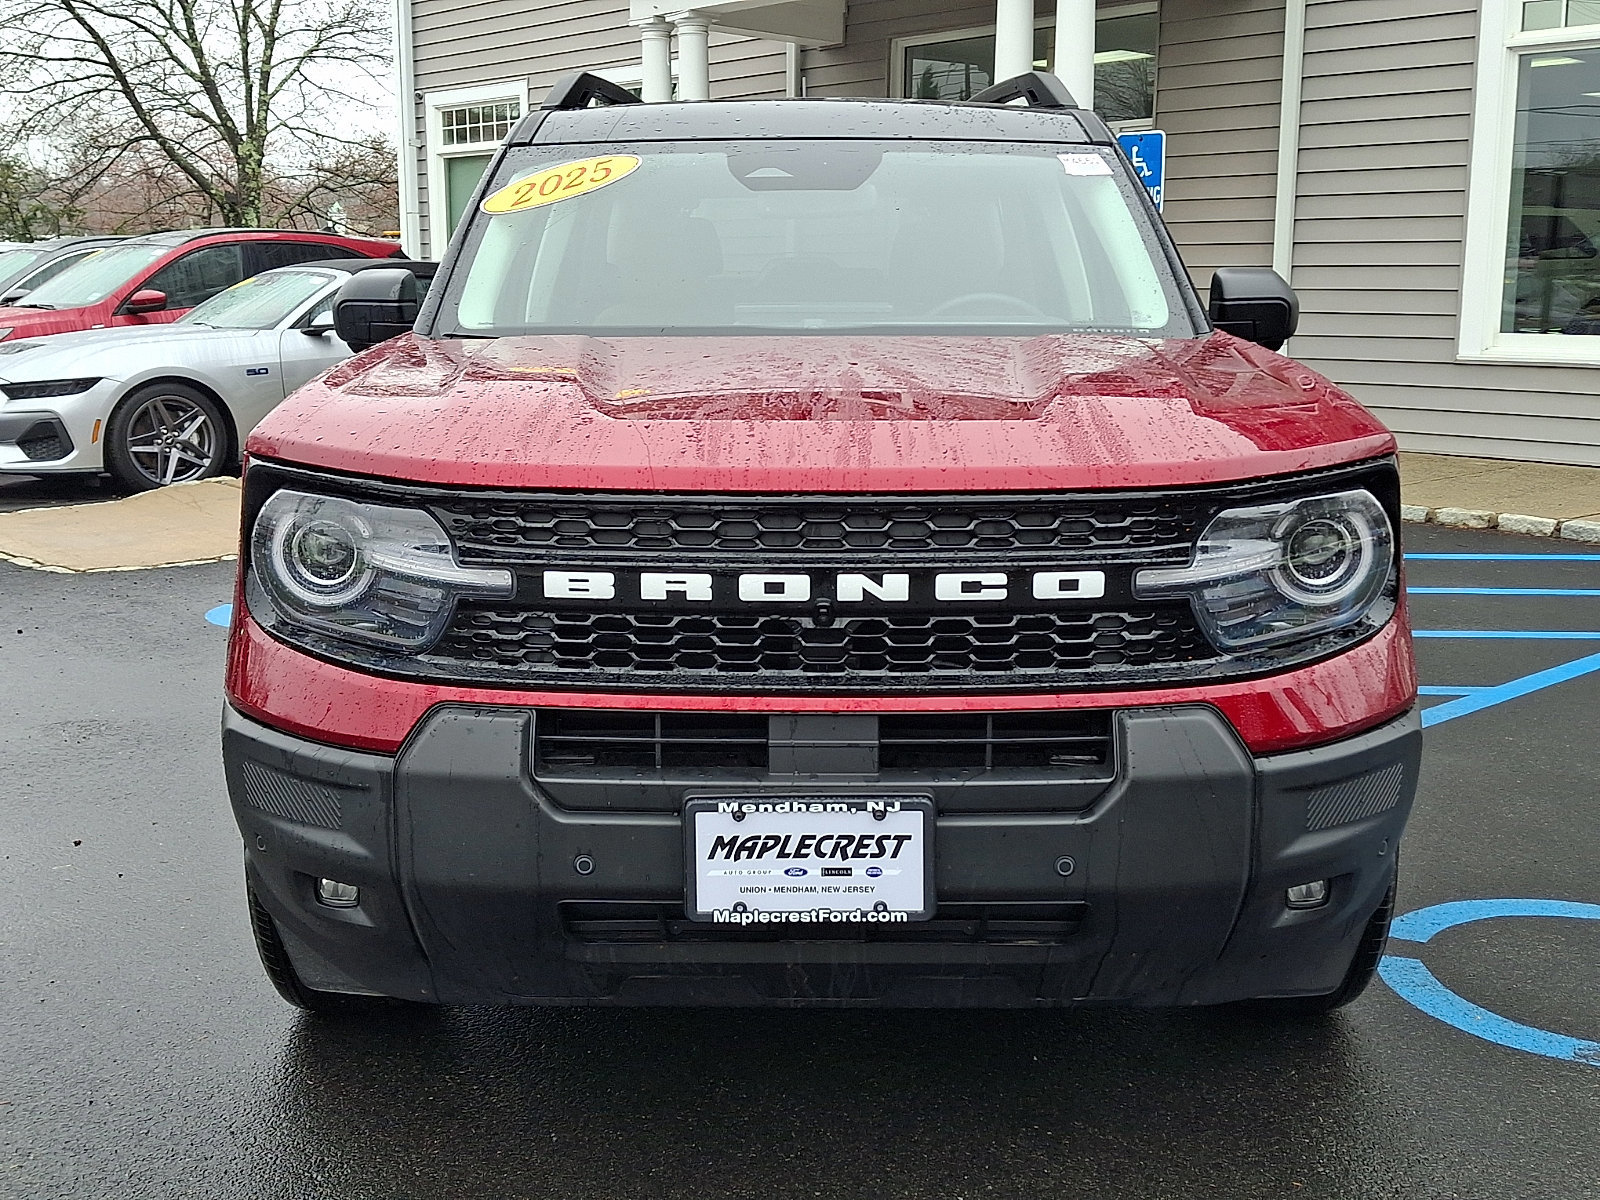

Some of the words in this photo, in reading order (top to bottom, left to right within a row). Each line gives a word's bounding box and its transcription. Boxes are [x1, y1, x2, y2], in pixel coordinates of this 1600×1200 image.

[511, 160, 612, 207] 2025
[543, 571, 1105, 602] BRONCO
[718, 802, 858, 814] Mendham,
[867, 802, 901, 812] NJ
[707, 834, 912, 862] MAPLECREST
[739, 886, 767, 894] UNION
[773, 886, 819, 895] MENDHAM,
[713, 909, 908, 926] MaplecrestFord.com
